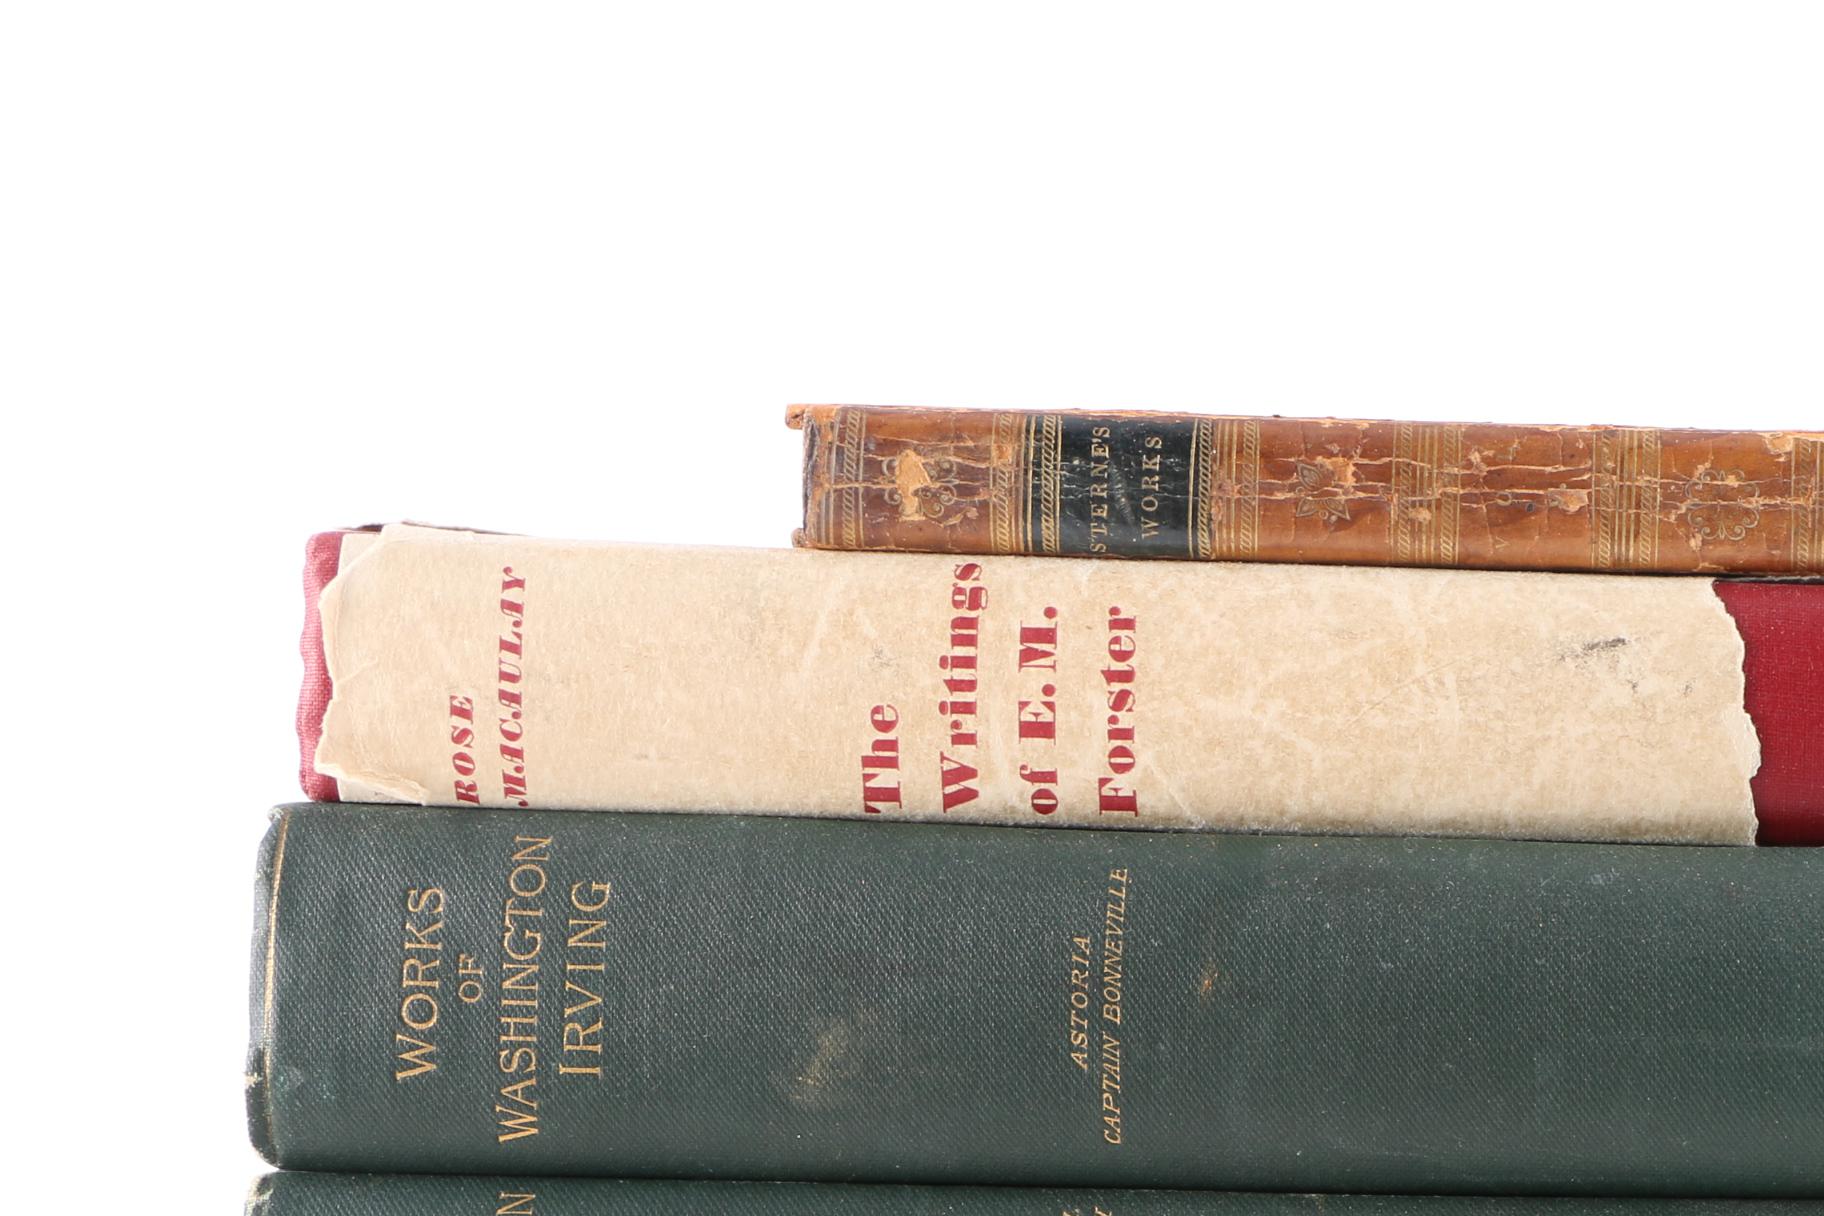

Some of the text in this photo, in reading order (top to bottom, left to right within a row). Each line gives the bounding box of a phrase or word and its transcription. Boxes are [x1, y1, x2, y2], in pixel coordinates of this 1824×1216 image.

[1089, 426, 1110, 553] STERNE'S
[1141, 436, 1162, 540] WORKS
[450, 695, 480, 806] ROSE
[498, 566, 528, 807] MACAULAY
[861, 704, 902, 813] The
[939, 563, 988, 813] Writings
[1018, 606, 1059, 815] of E. M.
[1098, 606, 1138, 818] Forster
[395, 887, 445, 1081] WORKS
[458, 953, 483, 1003] OF
[496, 835, 552, 1142] WASHINGTON
[558, 881, 611, 1079] IRVING
[1071, 935, 1091, 1071] ASTORIA
[1103, 867, 1127, 1144] CAPTAIN BONNEVILLE
